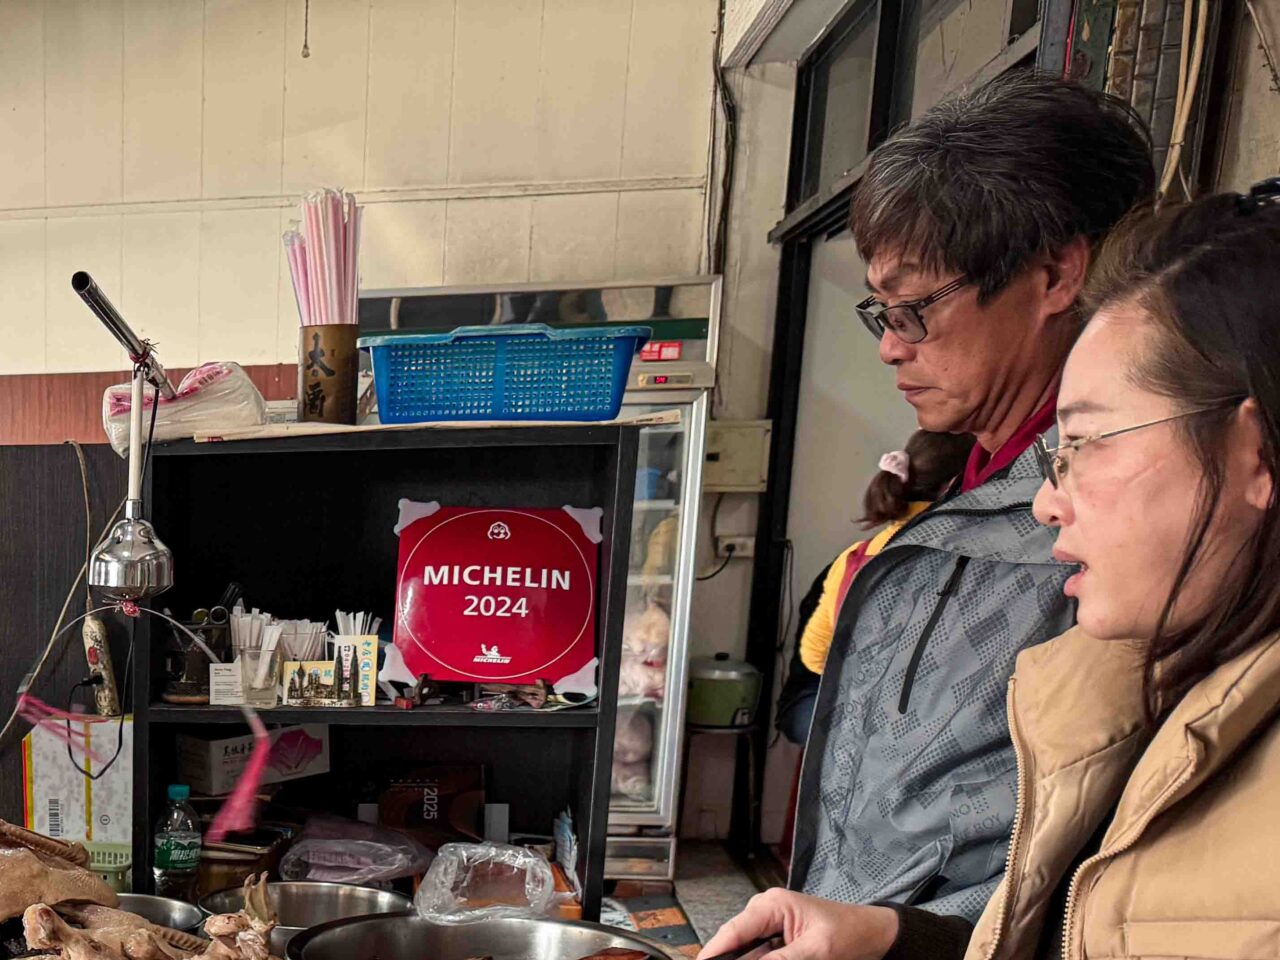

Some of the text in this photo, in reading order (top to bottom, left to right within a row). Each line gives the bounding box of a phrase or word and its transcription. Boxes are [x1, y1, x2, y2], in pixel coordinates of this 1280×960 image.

[423, 565, 571, 591] MICHELIN
[463, 595, 529, 618] 2024
[472, 655, 512, 664] MICHELIN
[423, 787, 438, 820] 2025
